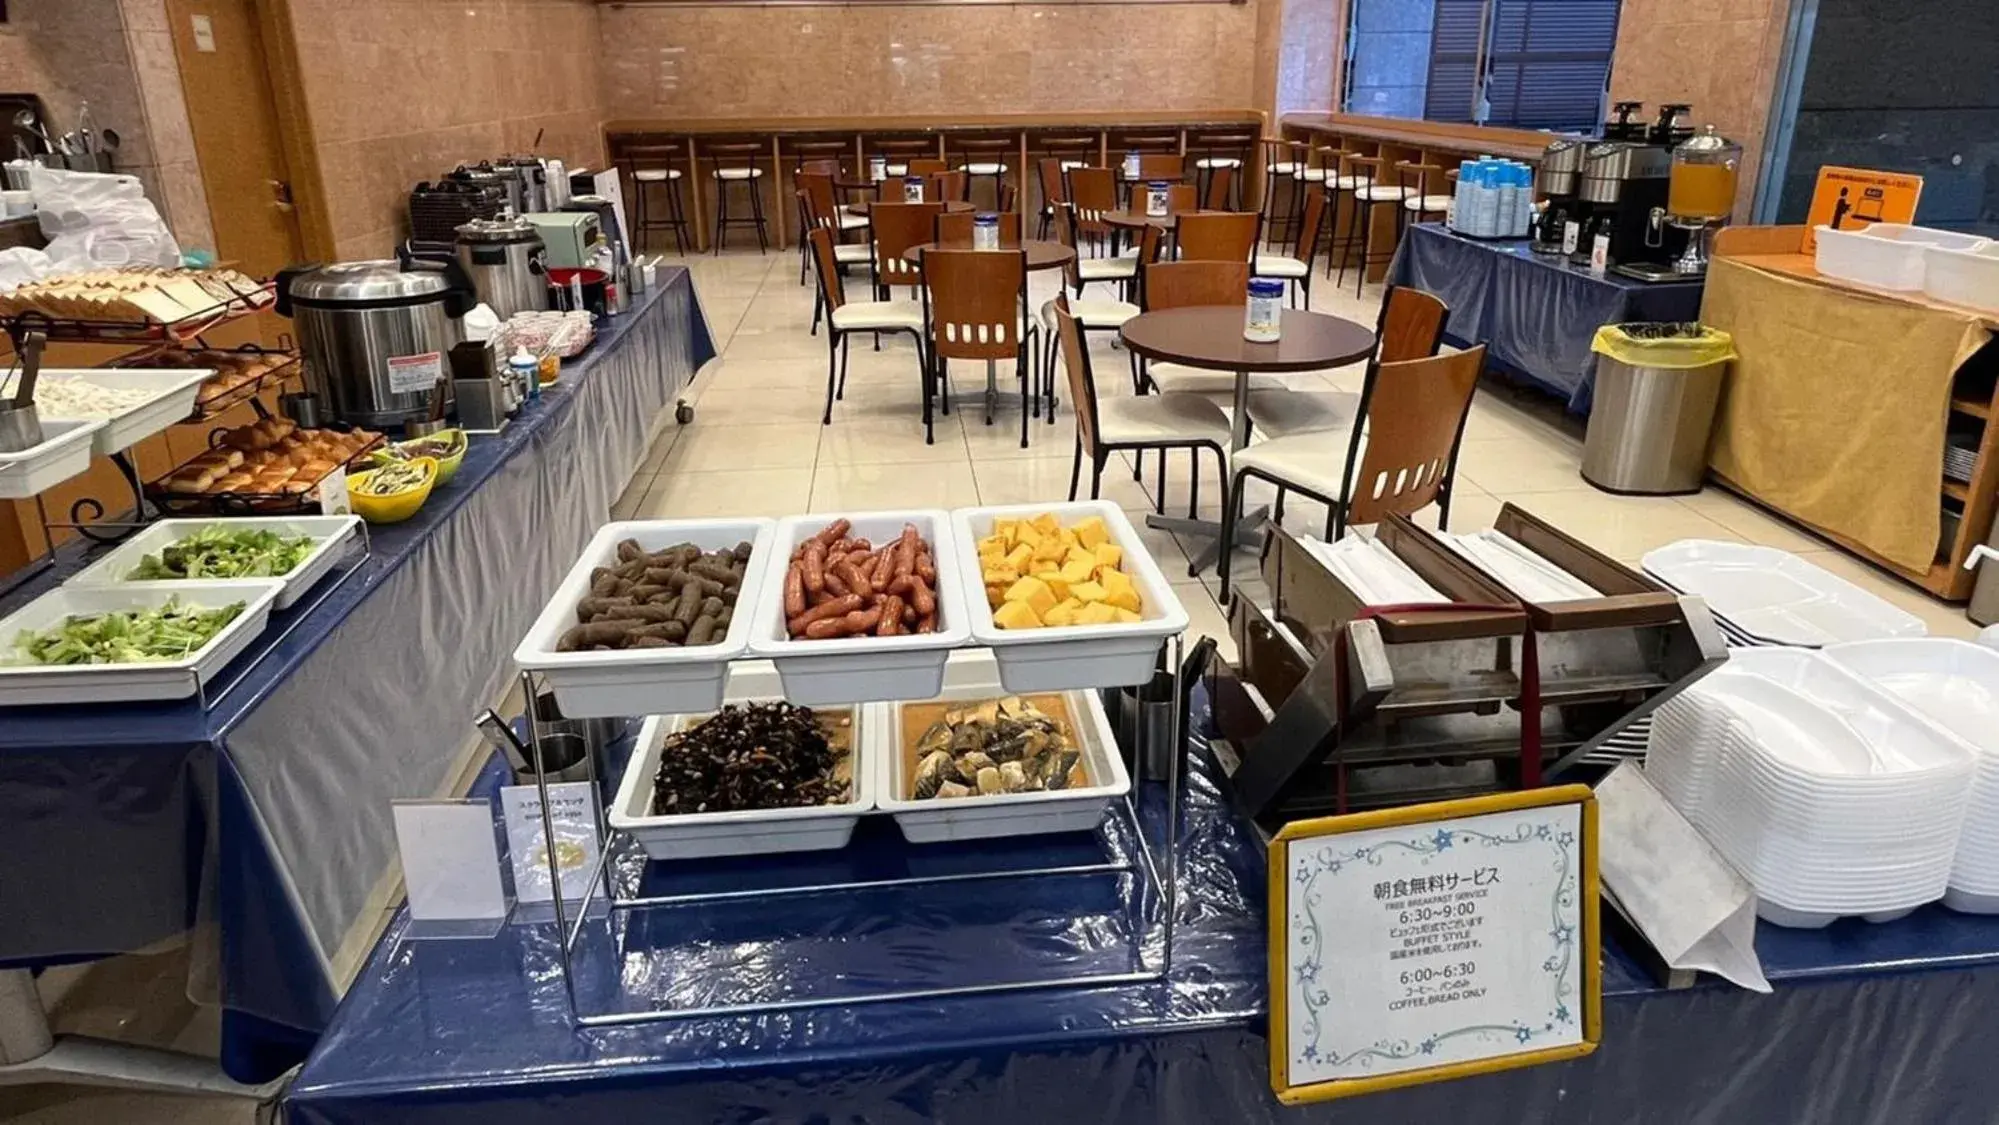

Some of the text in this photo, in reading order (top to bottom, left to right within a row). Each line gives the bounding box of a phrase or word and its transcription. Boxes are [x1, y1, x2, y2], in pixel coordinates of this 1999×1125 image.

[1373, 867, 1501, 900] 朝食無料サービス
[1385, 889, 1489, 911] FREE BREAKFAST SERVICE
[1404, 930, 1471, 947] BUFFET STYLE
[1462, 988, 1488, 999] ONLY
